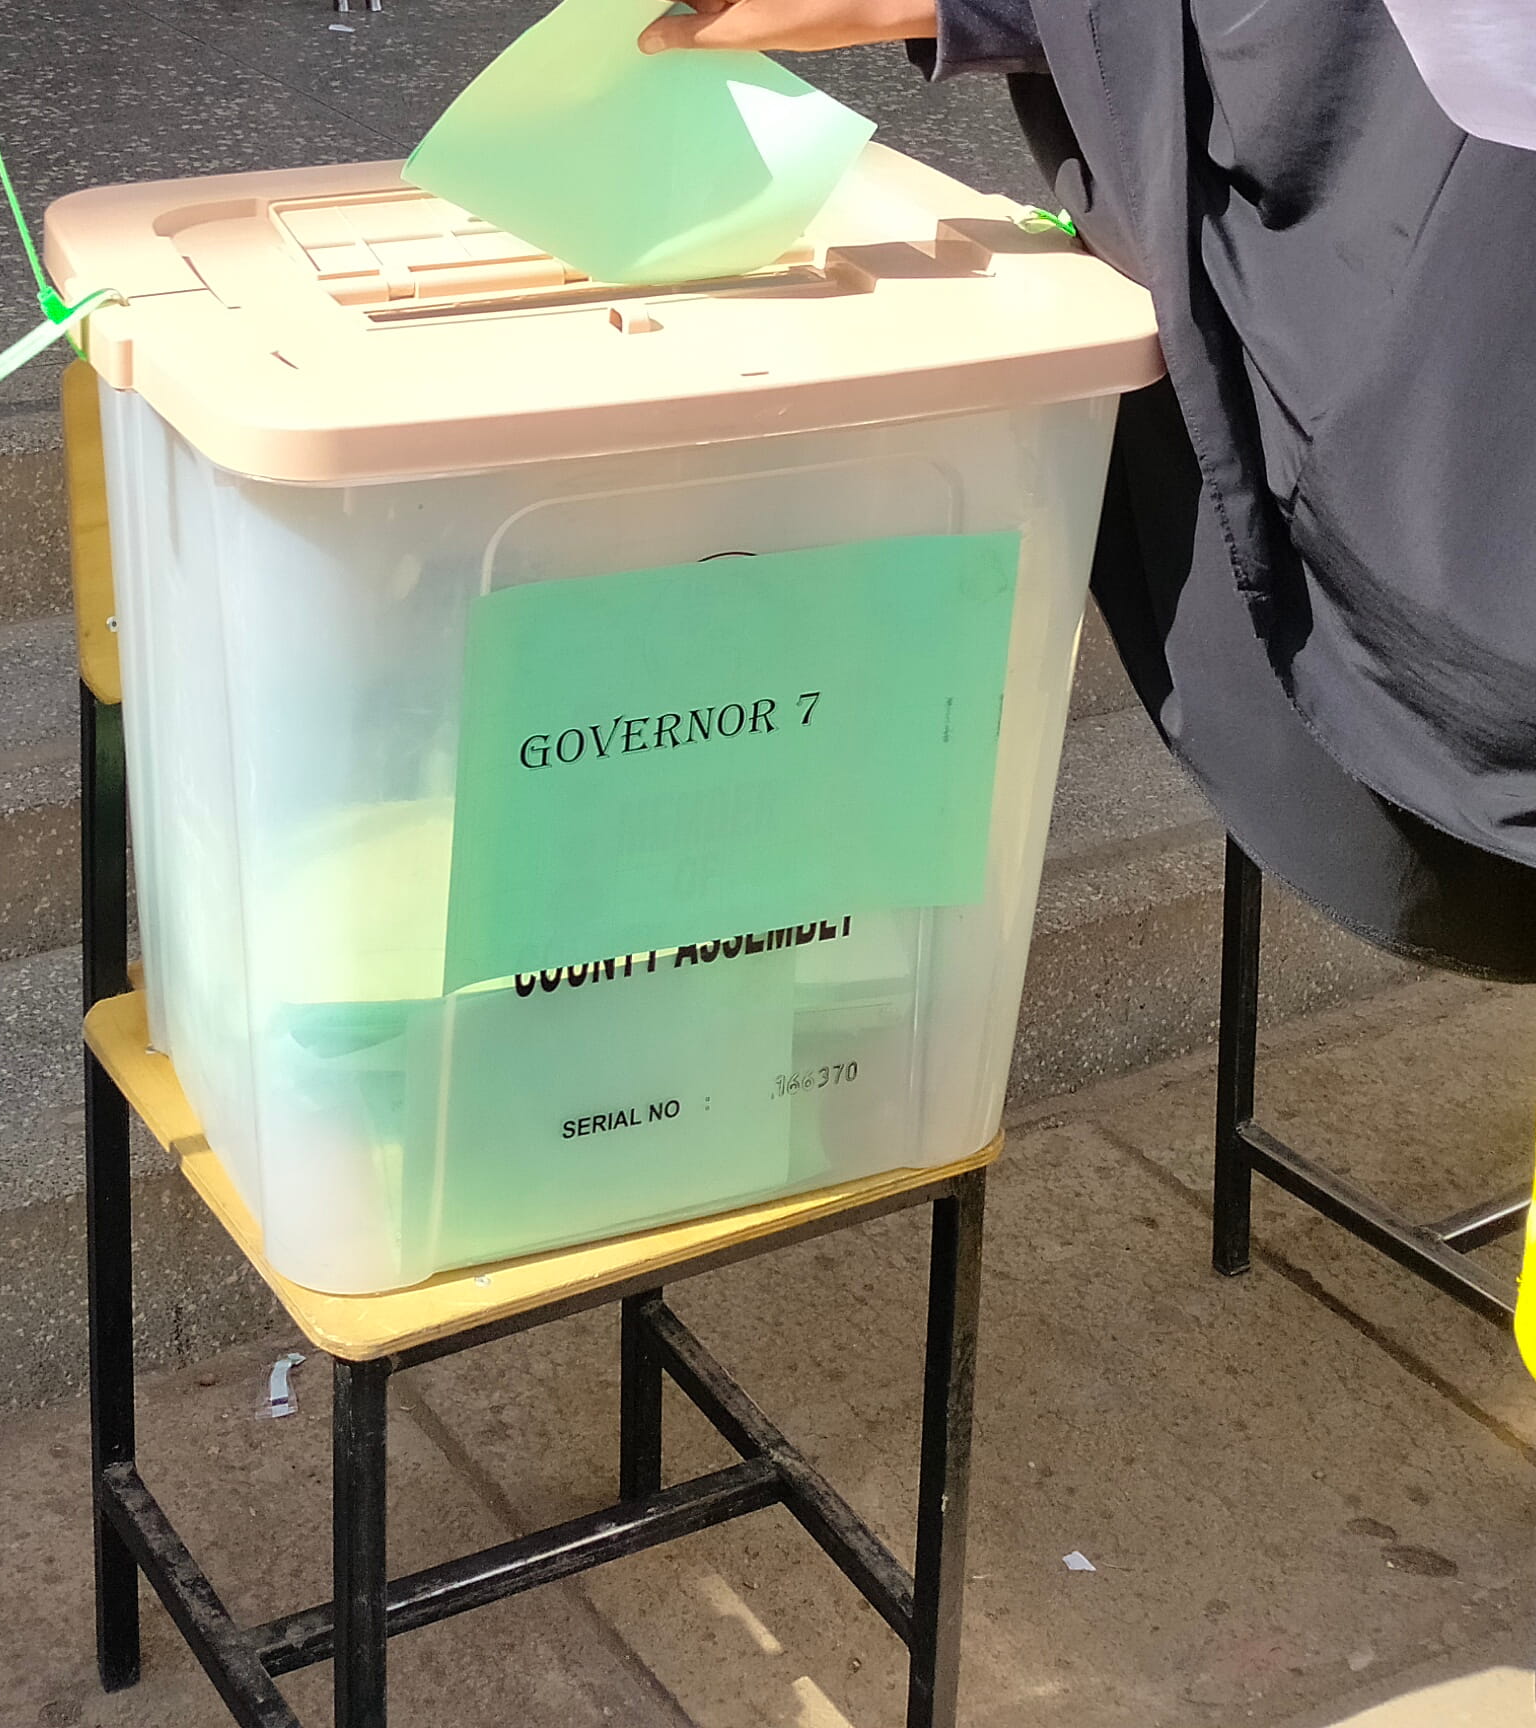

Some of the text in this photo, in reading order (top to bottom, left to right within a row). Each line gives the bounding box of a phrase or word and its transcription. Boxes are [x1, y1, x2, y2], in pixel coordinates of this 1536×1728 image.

[519, 690, 822, 770] GOVERNOR 7
[562, 1108, 642, 1140] SERIAL
[648, 1099, 682, 1123] NO
